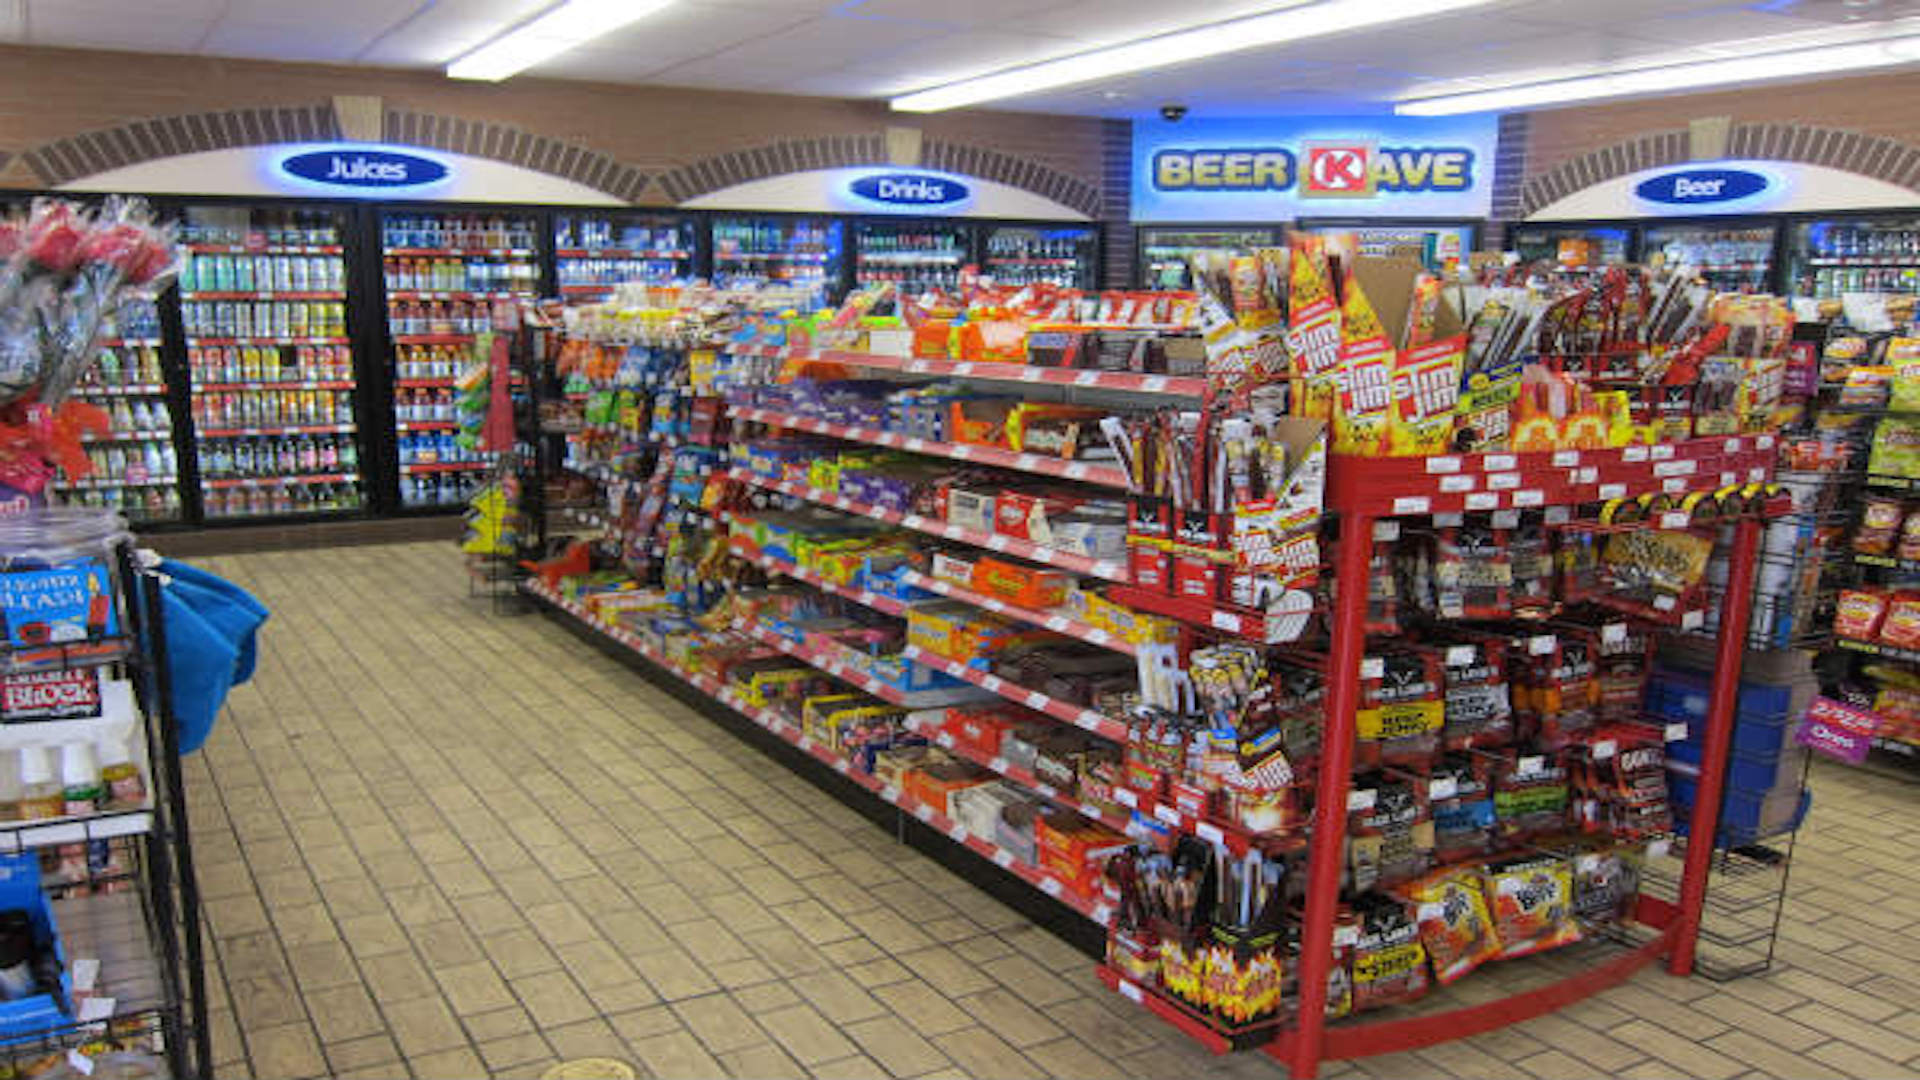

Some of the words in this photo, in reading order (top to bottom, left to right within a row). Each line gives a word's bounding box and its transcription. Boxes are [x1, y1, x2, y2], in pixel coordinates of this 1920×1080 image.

[326, 155, 407, 180] Juices
[1157, 152, 1288, 187] BEER
[877, 179, 945, 201] Drinks
[1673, 176, 1726, 199] Beer
